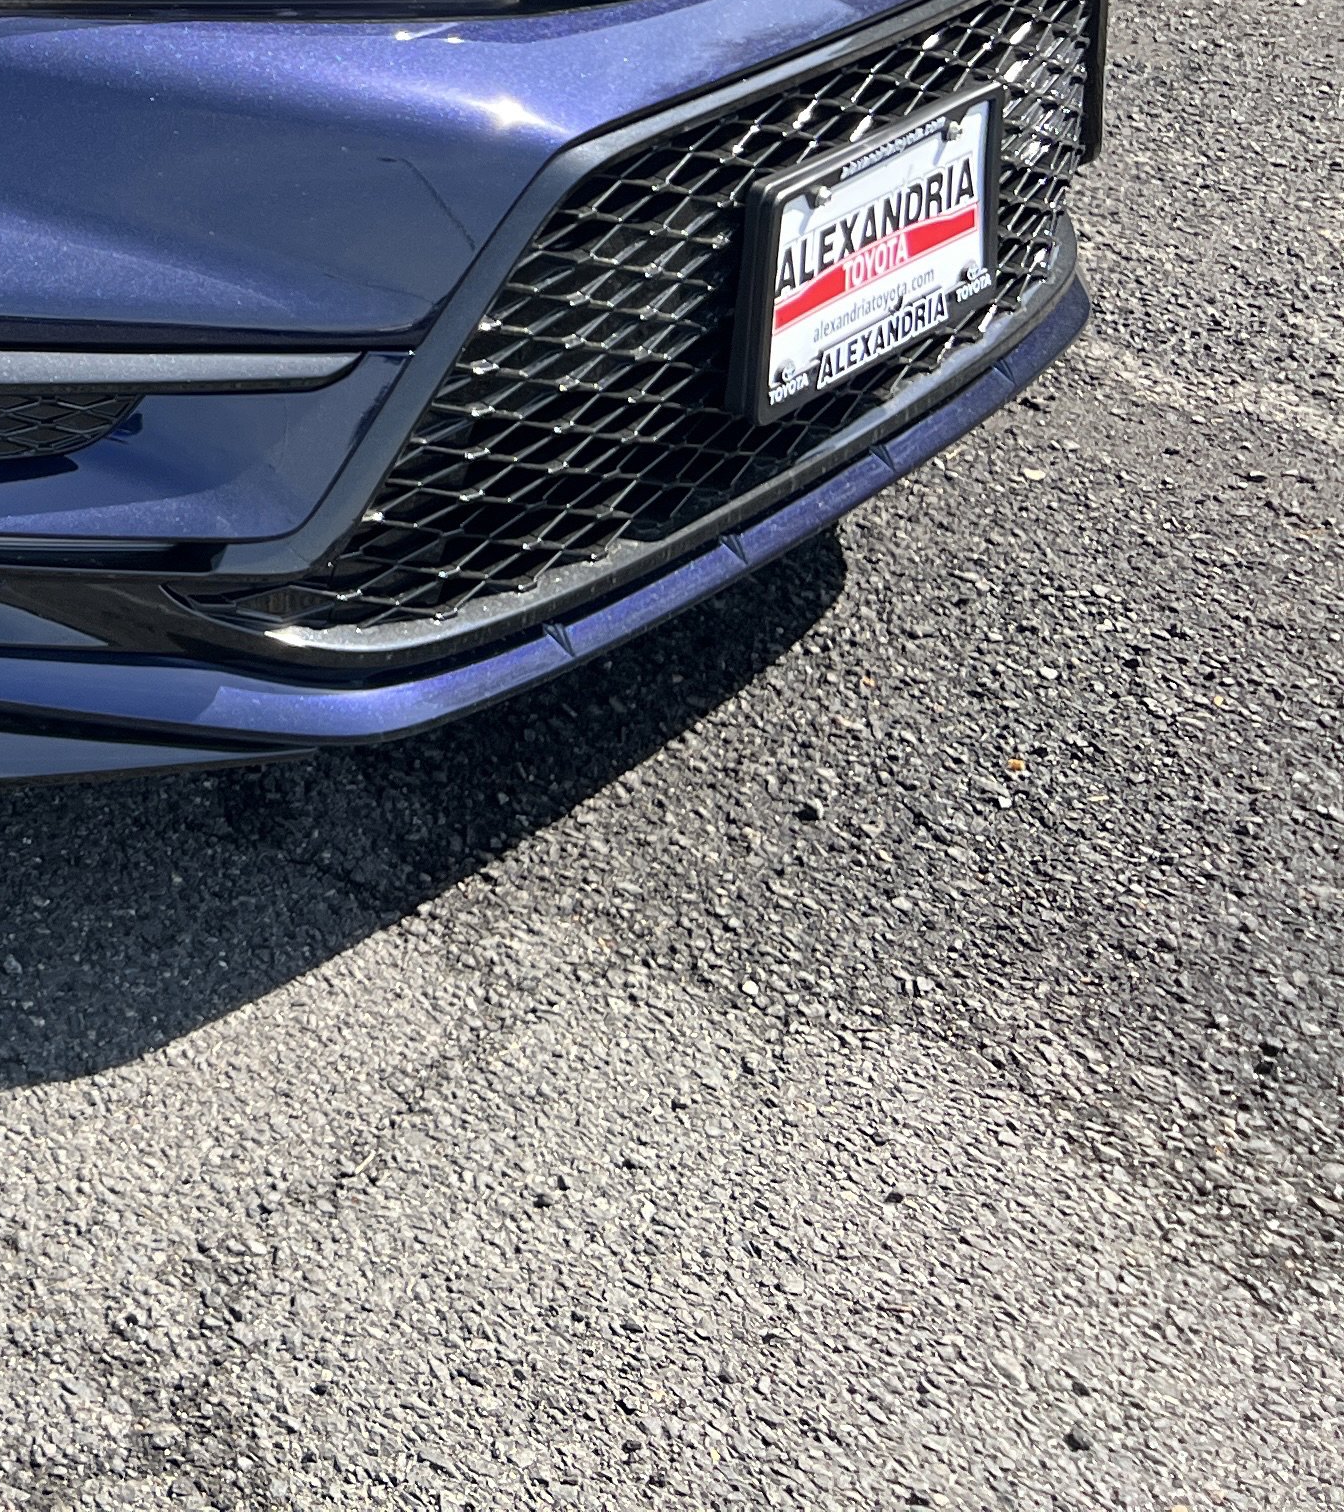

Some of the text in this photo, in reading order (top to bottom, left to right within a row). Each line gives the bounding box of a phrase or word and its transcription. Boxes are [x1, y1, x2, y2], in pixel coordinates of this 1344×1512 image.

[776, 157, 976, 298] ALEXANDRIA
[843, 231, 909, 291] TOYOTA
[813, 267, 934, 343] alexandriatoyota.com
[956, 273, 992, 303] TOYOTA
[818, 289, 949, 387] ALEXANDRIA
[768, 373, 809, 405] TOYOTA
